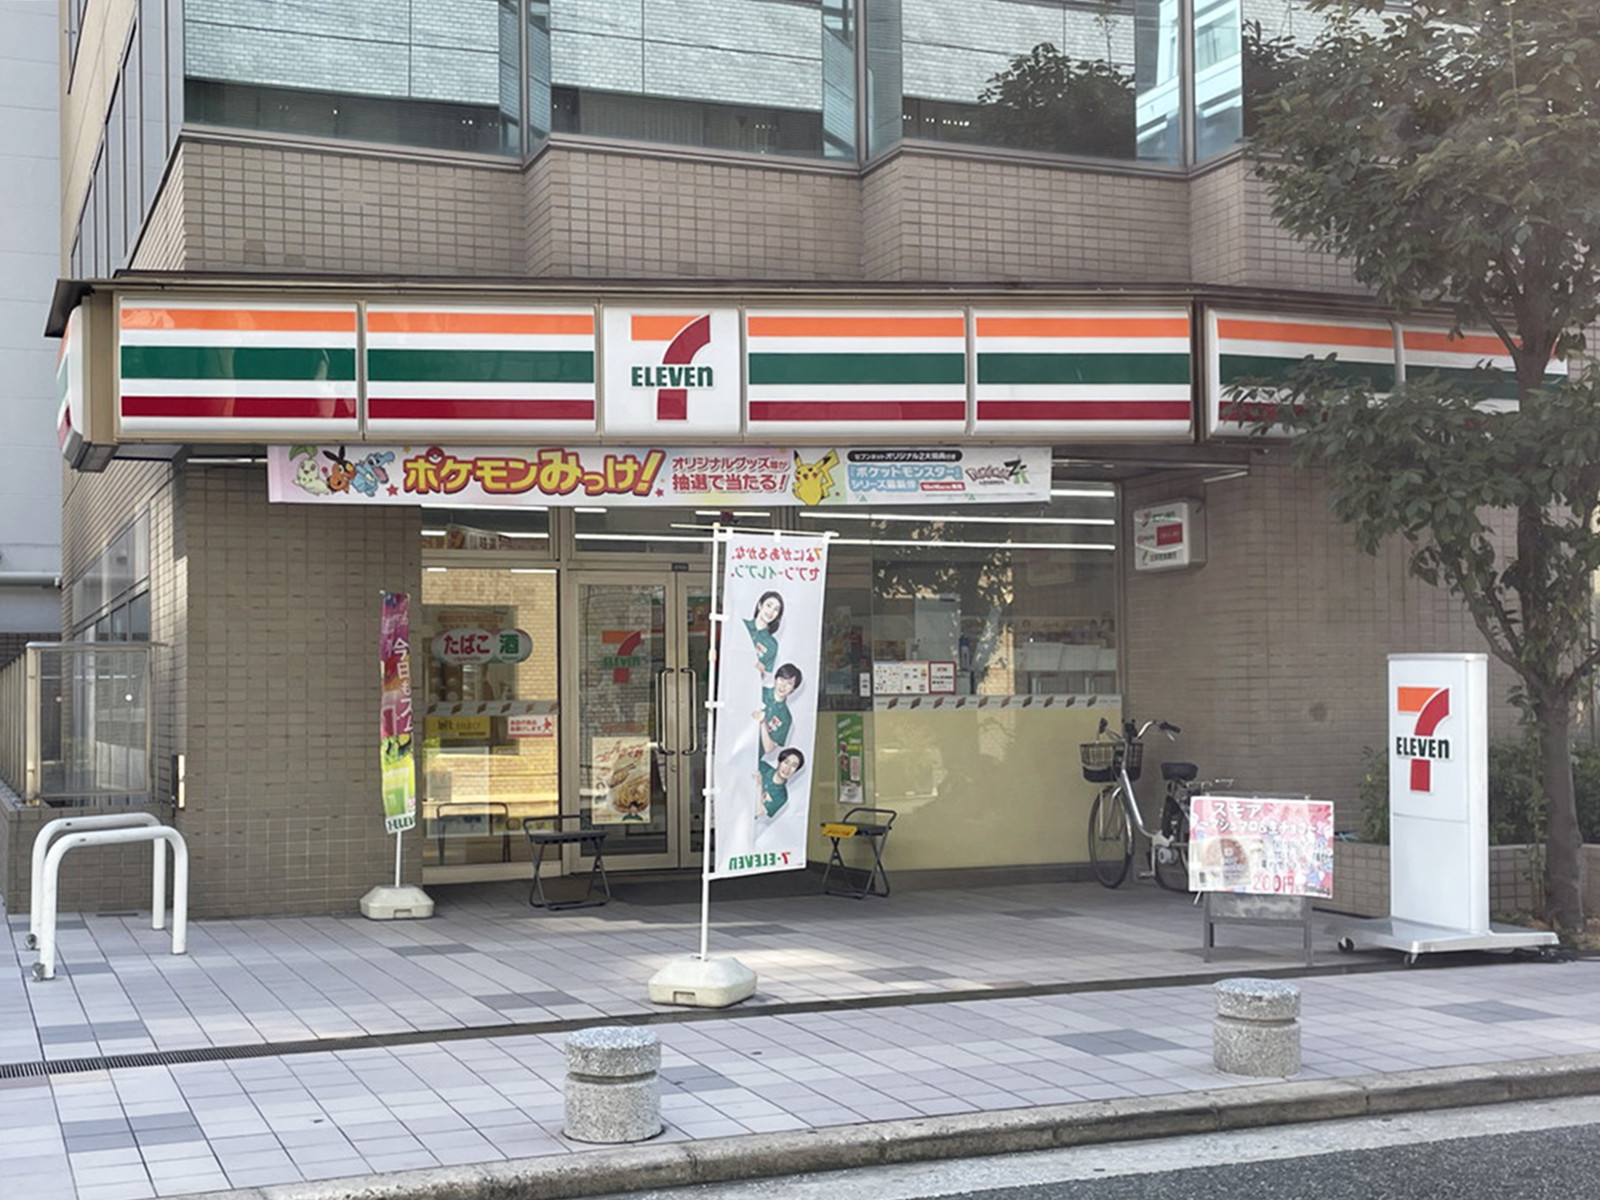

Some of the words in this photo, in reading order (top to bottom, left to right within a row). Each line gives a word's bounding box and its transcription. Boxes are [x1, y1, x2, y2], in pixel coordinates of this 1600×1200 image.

[443, 634, 491, 655] たばこ
[499, 634, 519, 654] 酒
